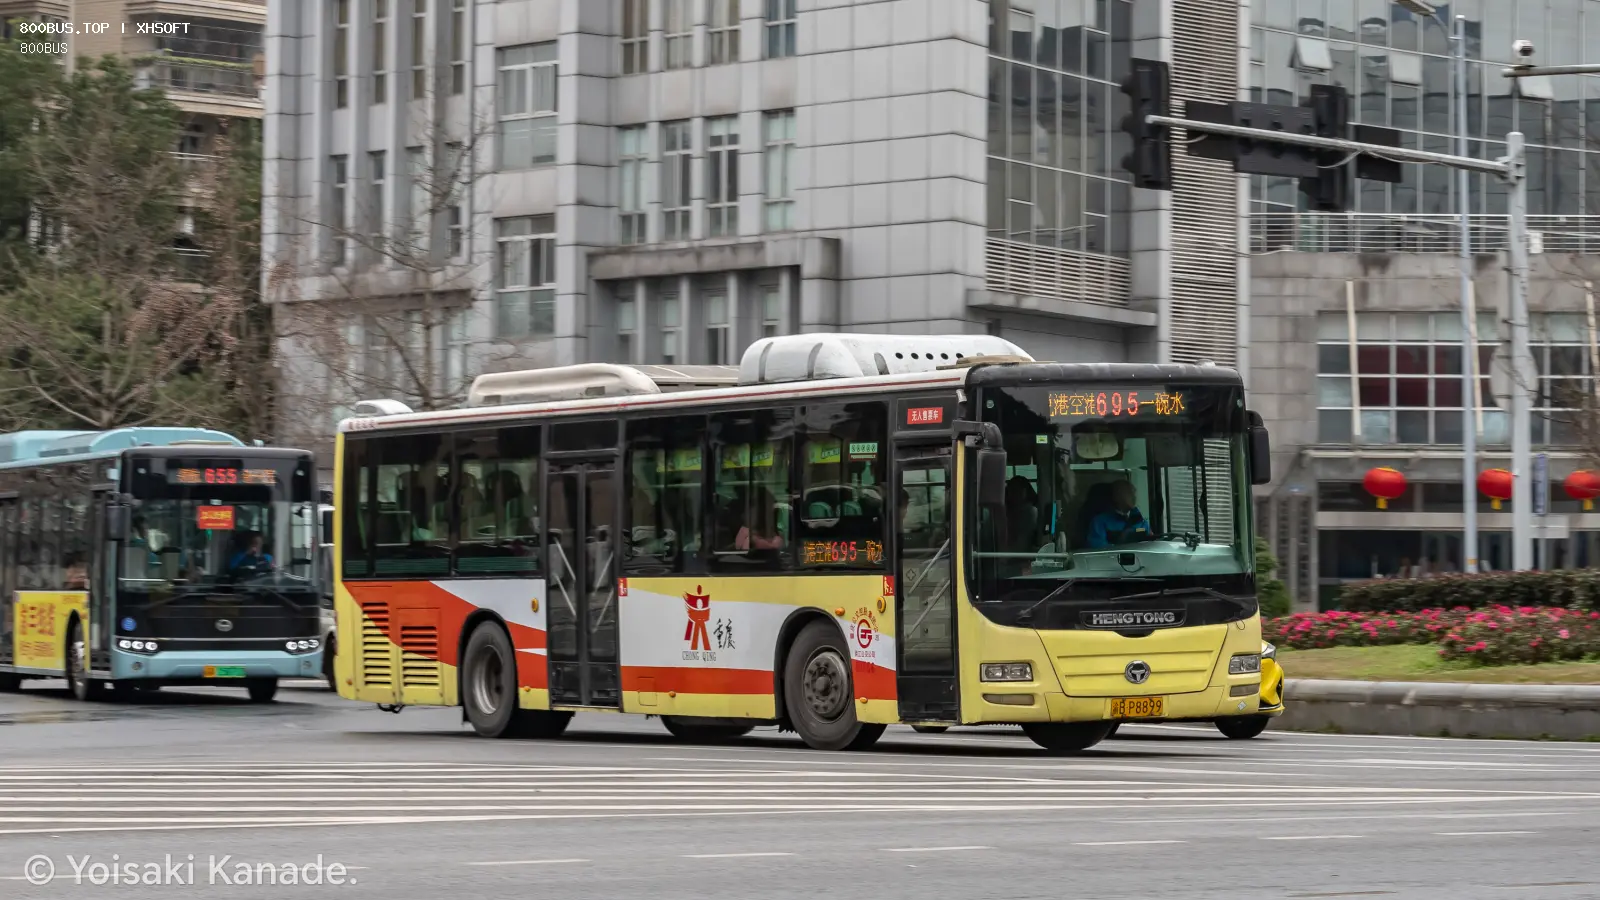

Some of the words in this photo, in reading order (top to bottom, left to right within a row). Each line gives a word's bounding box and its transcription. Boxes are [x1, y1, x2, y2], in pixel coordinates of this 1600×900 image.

[204, 468, 238, 484] 655
[1092, 611, 1175, 625] HENGTONG
[682, 651, 699, 660] CHONG
[702, 651, 717, 662] QING
